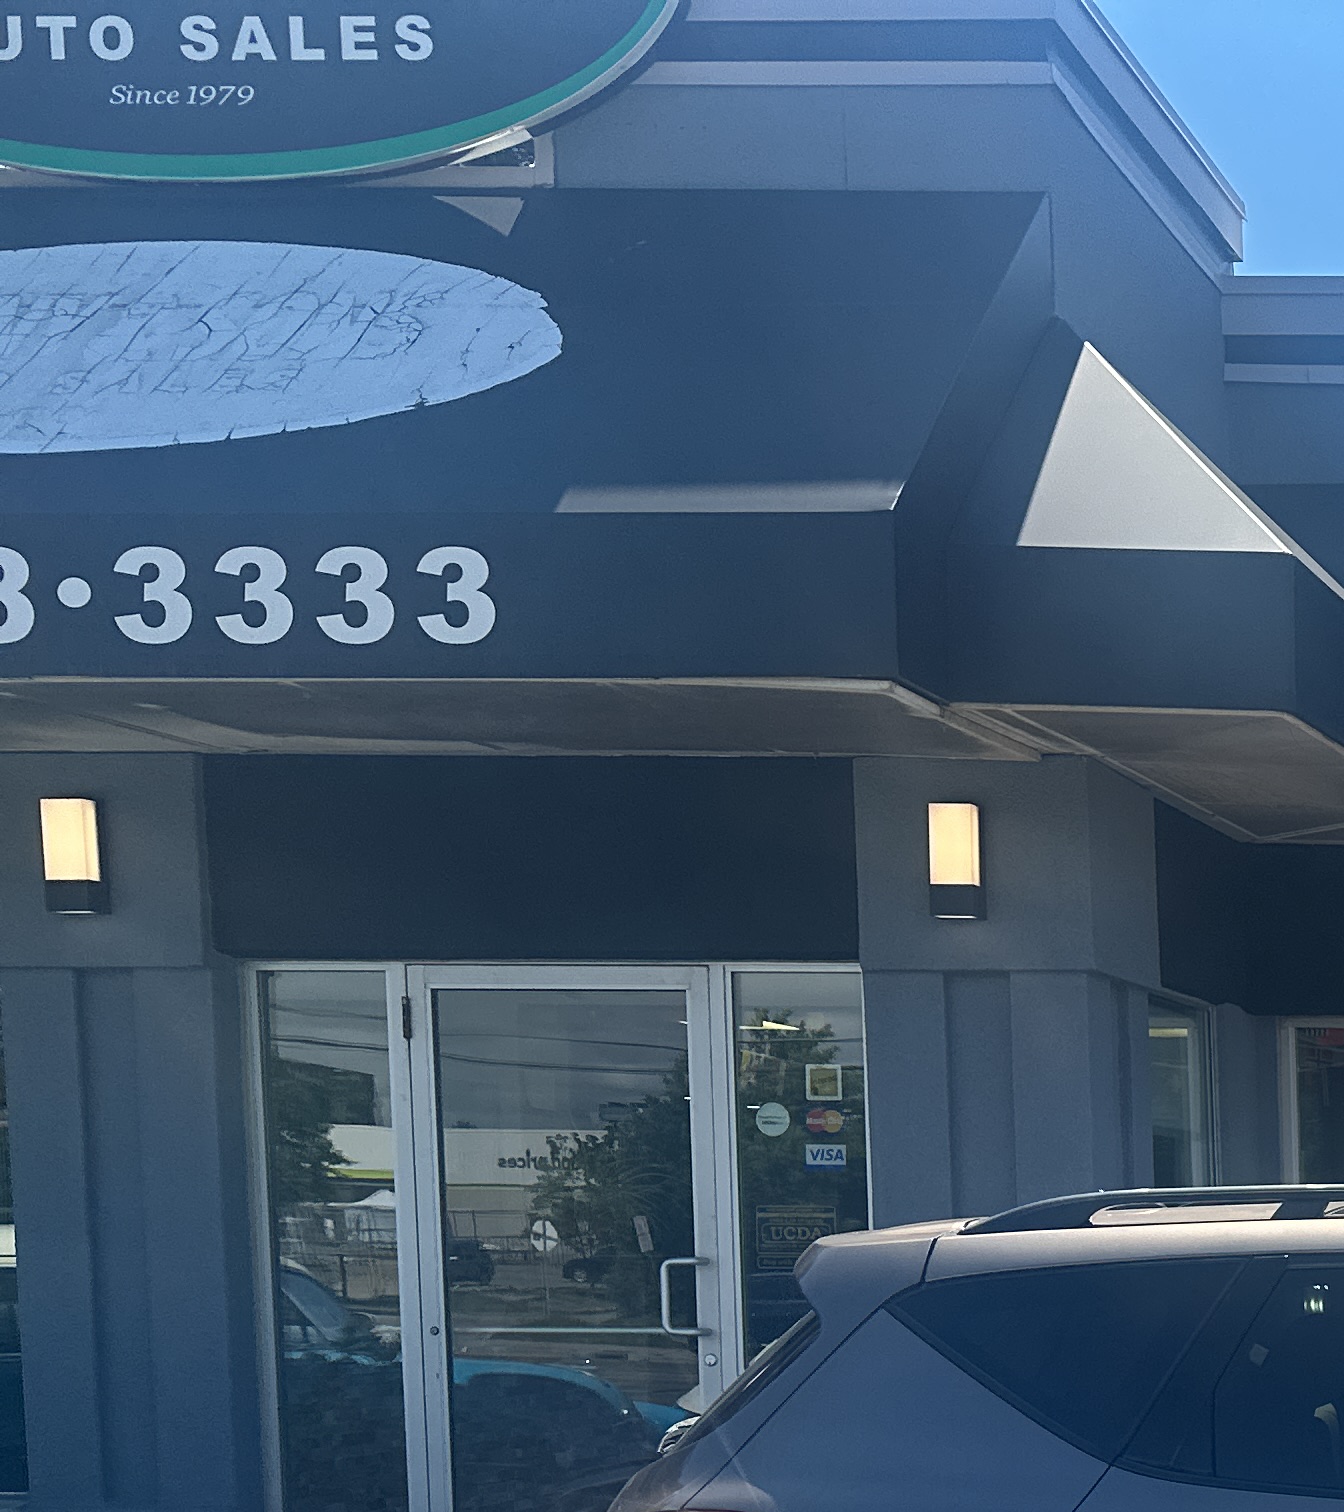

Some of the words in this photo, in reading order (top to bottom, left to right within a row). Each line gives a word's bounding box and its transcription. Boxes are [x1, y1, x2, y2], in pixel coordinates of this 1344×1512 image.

[179, 15, 434, 61] SALES
[109, 84, 180, 106] Since
[188, 84, 255, 107] 1979
[810, 1148, 845, 1161] VISA
[770, 1226, 822, 1241] UCDA
